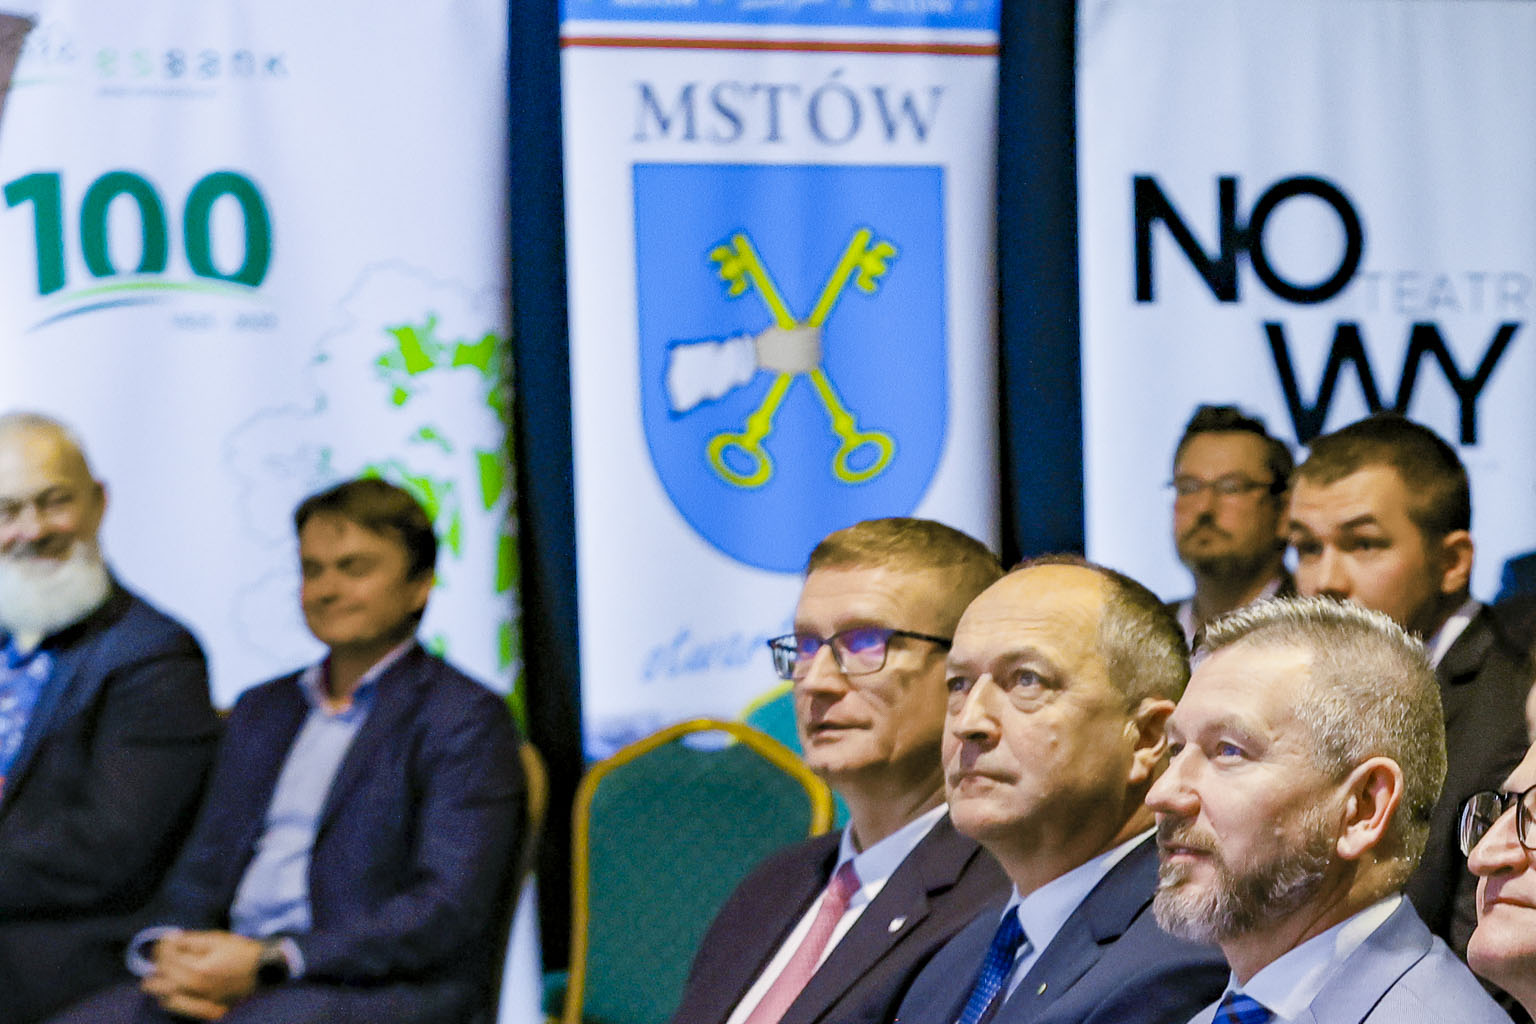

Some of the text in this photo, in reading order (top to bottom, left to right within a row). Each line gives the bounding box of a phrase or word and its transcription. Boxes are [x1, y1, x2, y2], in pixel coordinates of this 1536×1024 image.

[632, 70, 946, 145] MSTÓW
[4, 171, 273, 295] 100
[1132, 174, 1364, 303] NO
[1362, 271, 1533, 314] TEATR
[1264, 322, 1522, 445] WY
